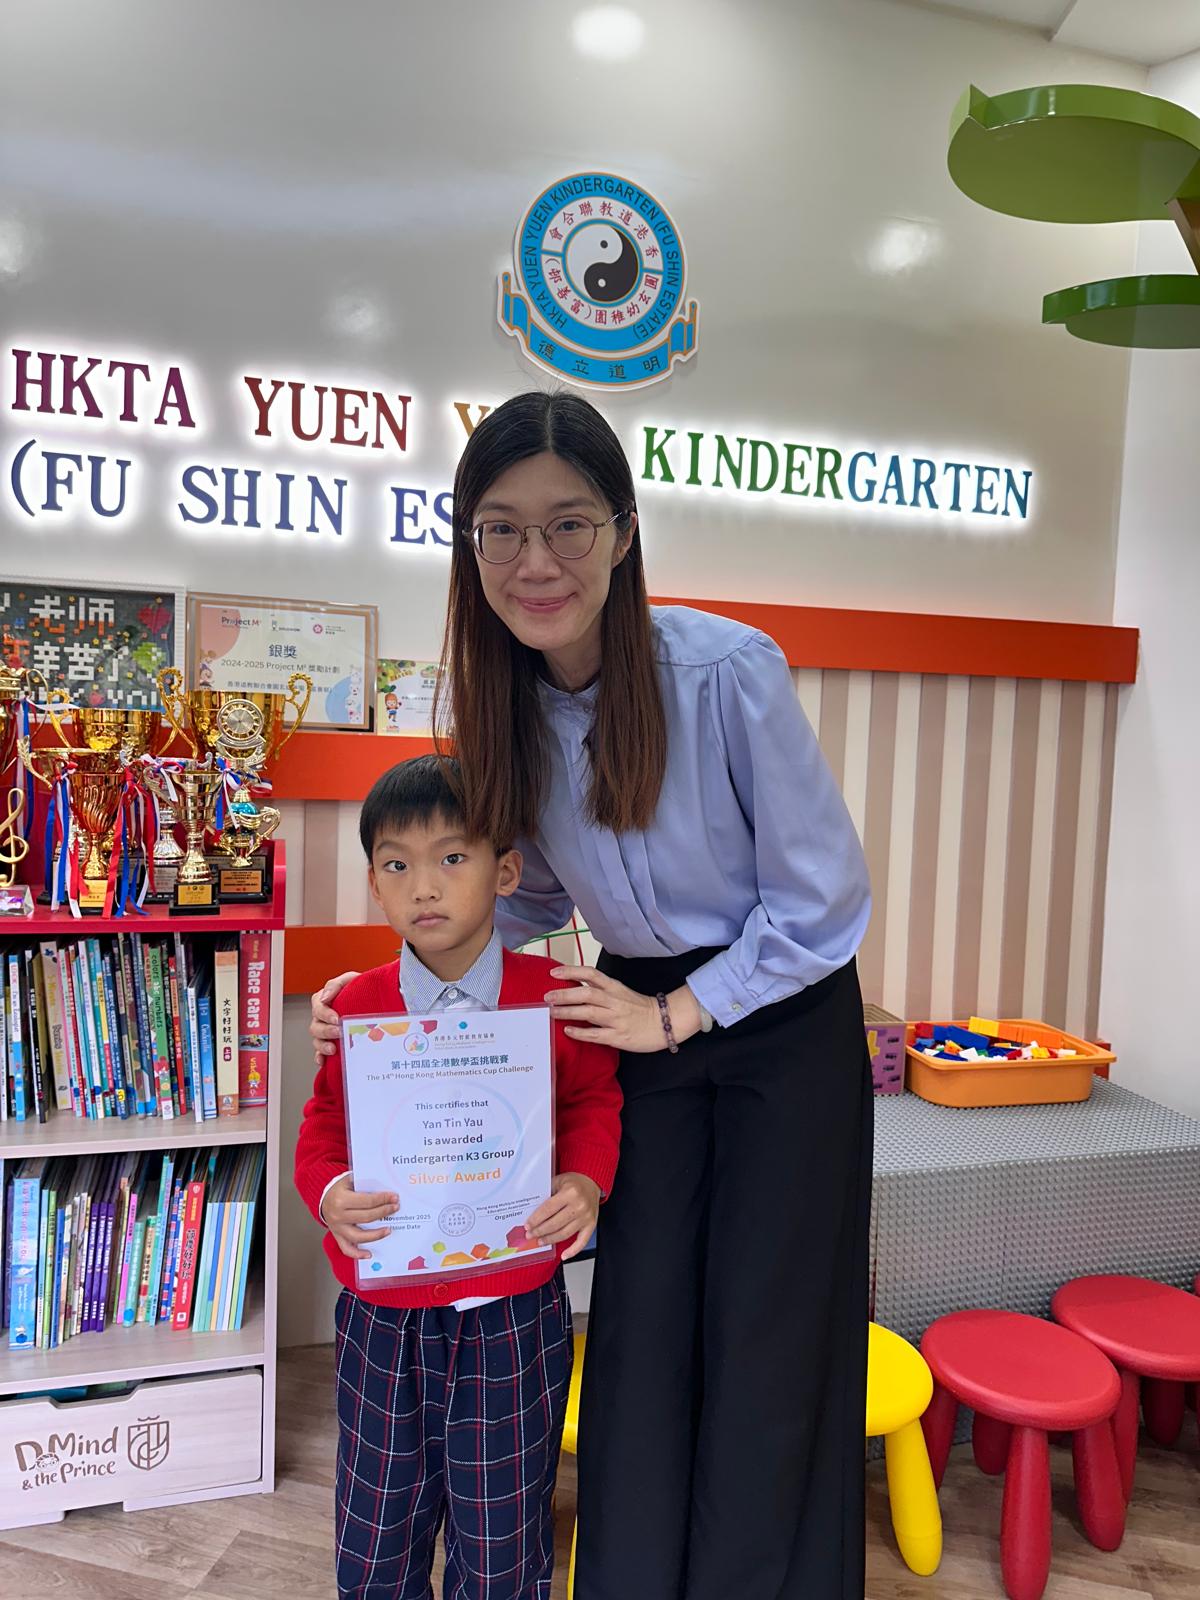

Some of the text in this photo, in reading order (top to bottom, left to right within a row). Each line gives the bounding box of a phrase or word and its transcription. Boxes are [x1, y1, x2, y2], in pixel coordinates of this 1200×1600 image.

[524, 177, 679, 340] HKTA YUEN YUEN KINDERGARTEN (FU SHIN ESTATE)
[11, 348, 196, 428] HKTA
[243, 376, 412, 452] YUEN
[640, 426, 1033, 519] KINDERGARTEN
[10, 438, 132, 518] (FU
[177, 464, 348, 536] SHIN
[268, 644, 297, 659] 銀獎
[221, 659, 265, 669] 2024-2025
[266, 662, 295, 672] Project
[152, 955, 160, 979] colors
[246, 961, 265, 1028] Race cars
[155, 997, 164, 1028] numbers
[223, 998, 232, 1043] 文字好好玩
[394, 1073, 414, 1081] Hong
[435, 1068, 482, 1078] Mathematics
[483, 1068, 498, 1076] Cup
[499, 1065, 534, 1074] Challenge
[415, 1099, 489, 1111] This certifies that
[422, 1117, 484, 1129] Yan Tin Yau
[423, 1134, 483, 1146] is awarded
[392, 1149, 515, 1166] Kindergarten K3 Group
[408, 1167, 501, 1185] Silver Award
[494, 1210, 523, 1221] Organizer
[48, 1426, 119, 1457] Mind
[22, 1460, 117, 1491] & the Prince
